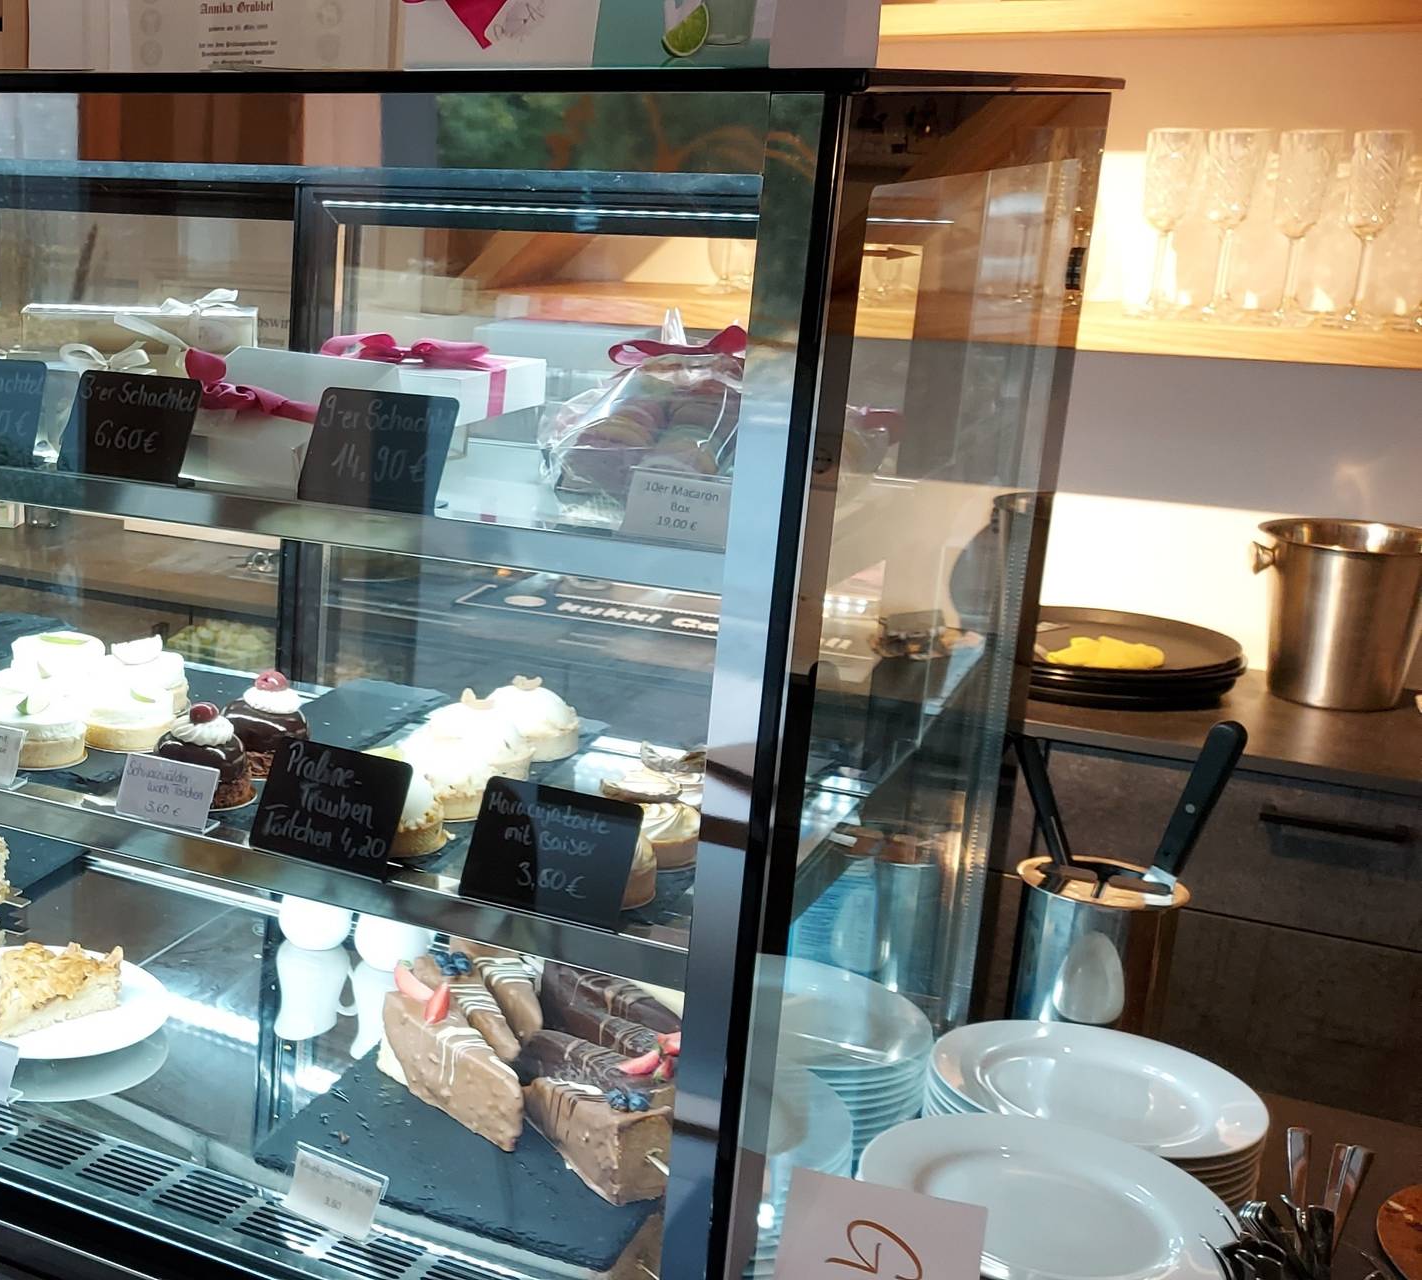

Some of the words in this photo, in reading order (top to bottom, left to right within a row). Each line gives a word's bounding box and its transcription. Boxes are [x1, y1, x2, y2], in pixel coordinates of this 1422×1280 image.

[117, 382, 196, 412] Schachtel
[645, 481, 669, 493] 10er
[671, 485, 719, 502] Macaron
[670, 502, 690, 513] Box
[286, 740, 363, 789] Praline-
[299, 782, 374, 830] Trauben
[504, 825, 533, 846] mit
[538, 830, 597, 857] Baiser
